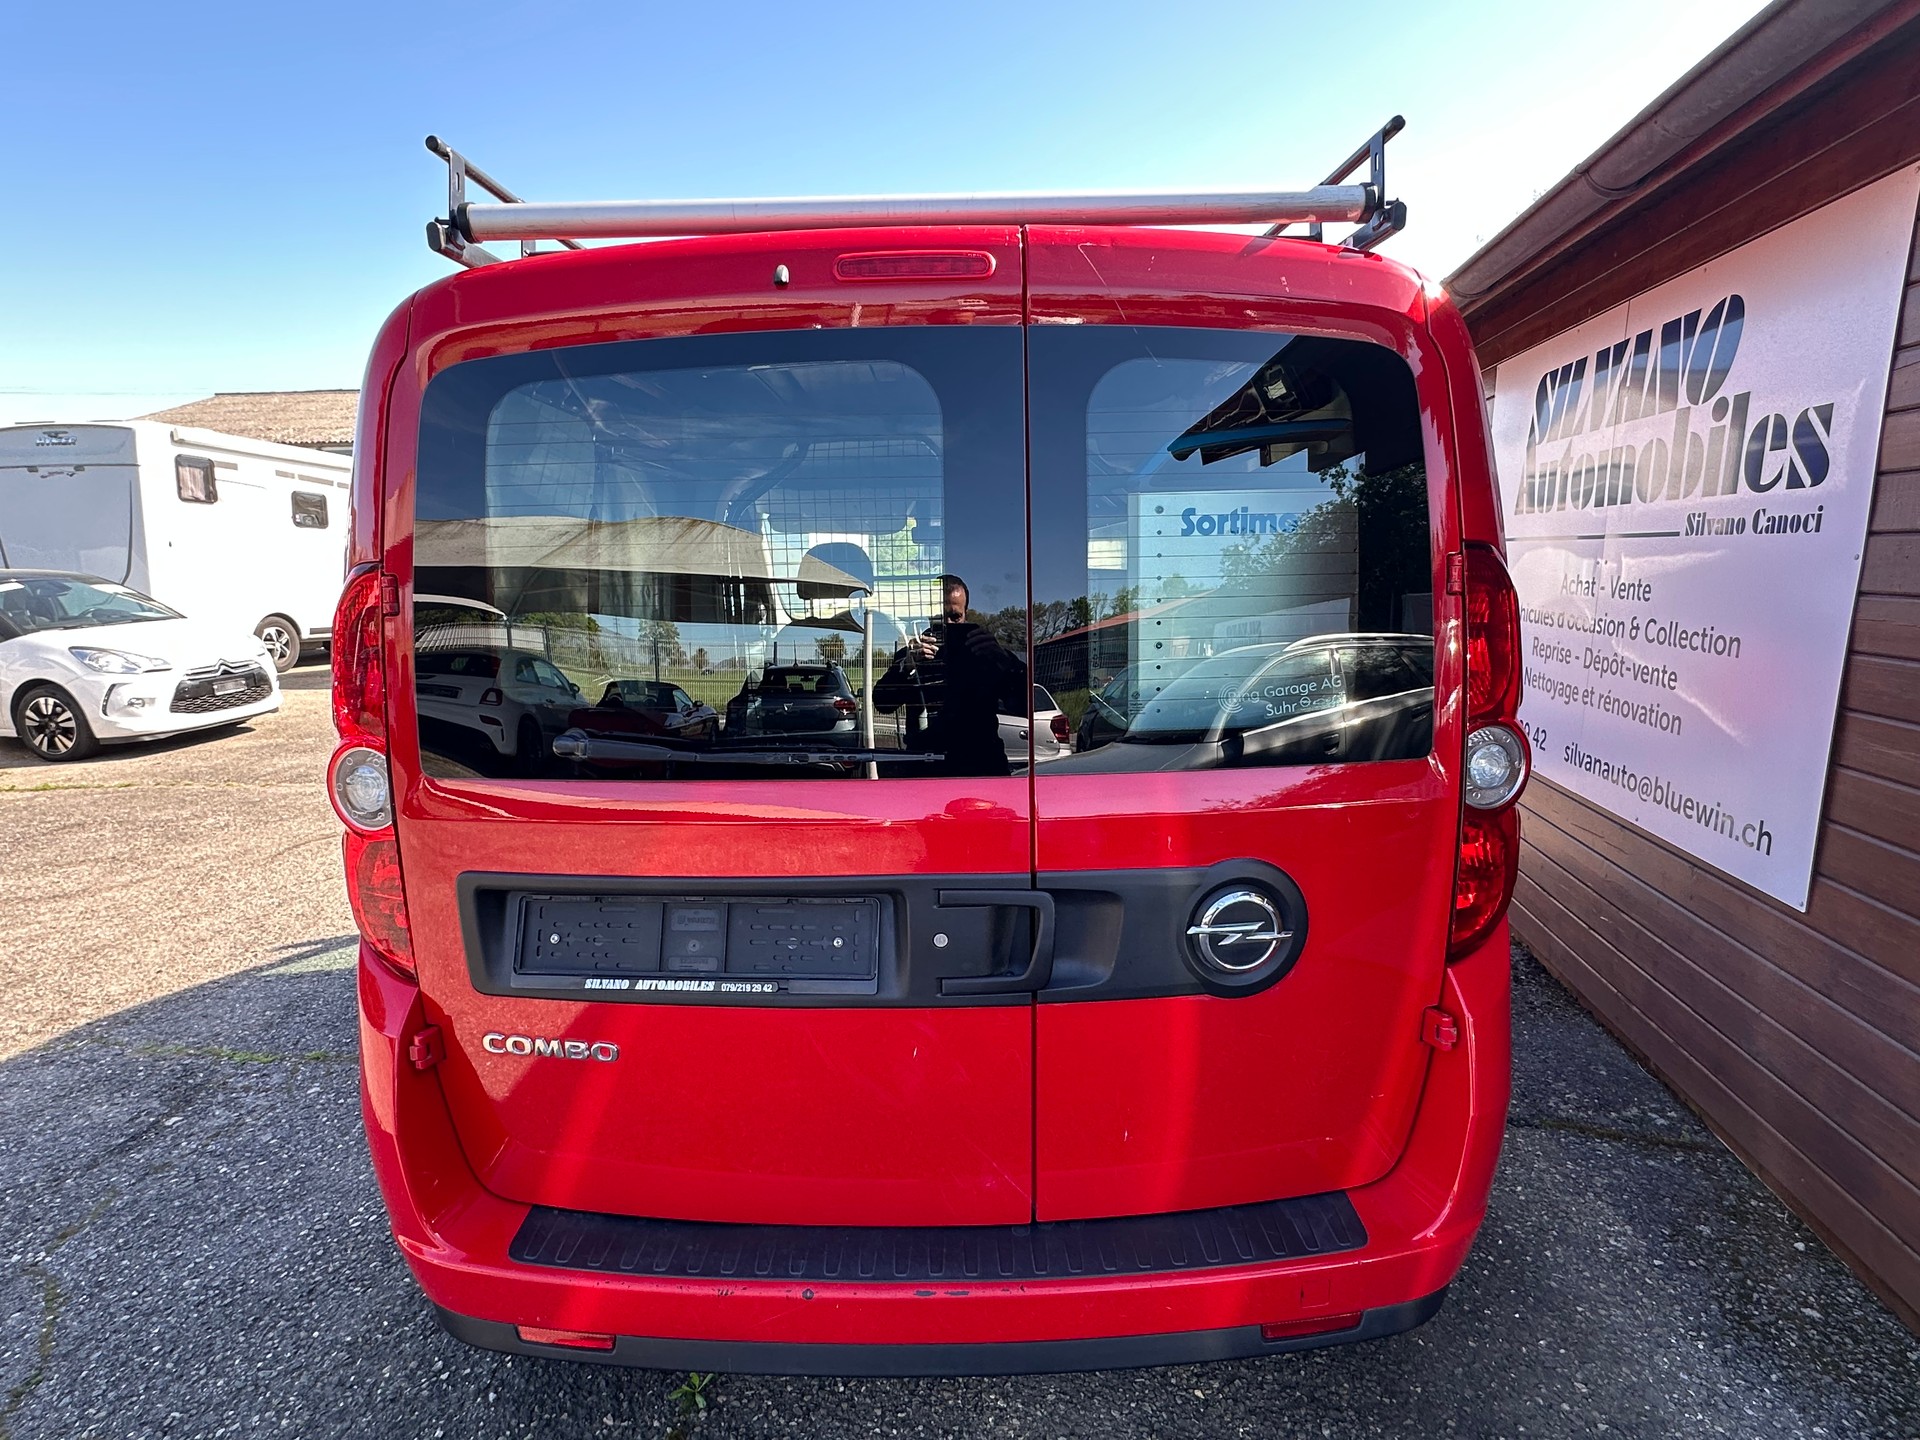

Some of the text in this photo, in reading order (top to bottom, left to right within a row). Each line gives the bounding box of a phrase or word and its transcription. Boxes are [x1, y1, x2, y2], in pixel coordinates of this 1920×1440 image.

[1515, 391, 1834, 515] Automobiles
[1685, 505, 1824, 538] Silvano Canoci
[1560, 574, 1597, 598] Achat
[1610, 576, 1652, 602] Vente
[1520, 605, 1742, 658] hicules doccasion & Collection
[1532, 636, 1572, 664] Reprise
[1583, 647, 1678, 690] Dépôt-vente
[1264, 681, 1317, 697] Garage
[1321, 675, 1342, 690] AG
[1524, 666, 1682, 735] Nettoyage et rénovation
[1265, 701, 1297, 716] Suhr
[1533, 727, 1547, 751] 42
[1563, 742, 1773, 856] silvanauto@bluewin.ch
[584, 978, 630, 990] SILVANO
[635, 979, 715, 992] AUTOMOBILES
[763, 983, 773, 993] 42
[482, 1032, 620, 1063] COMBO
